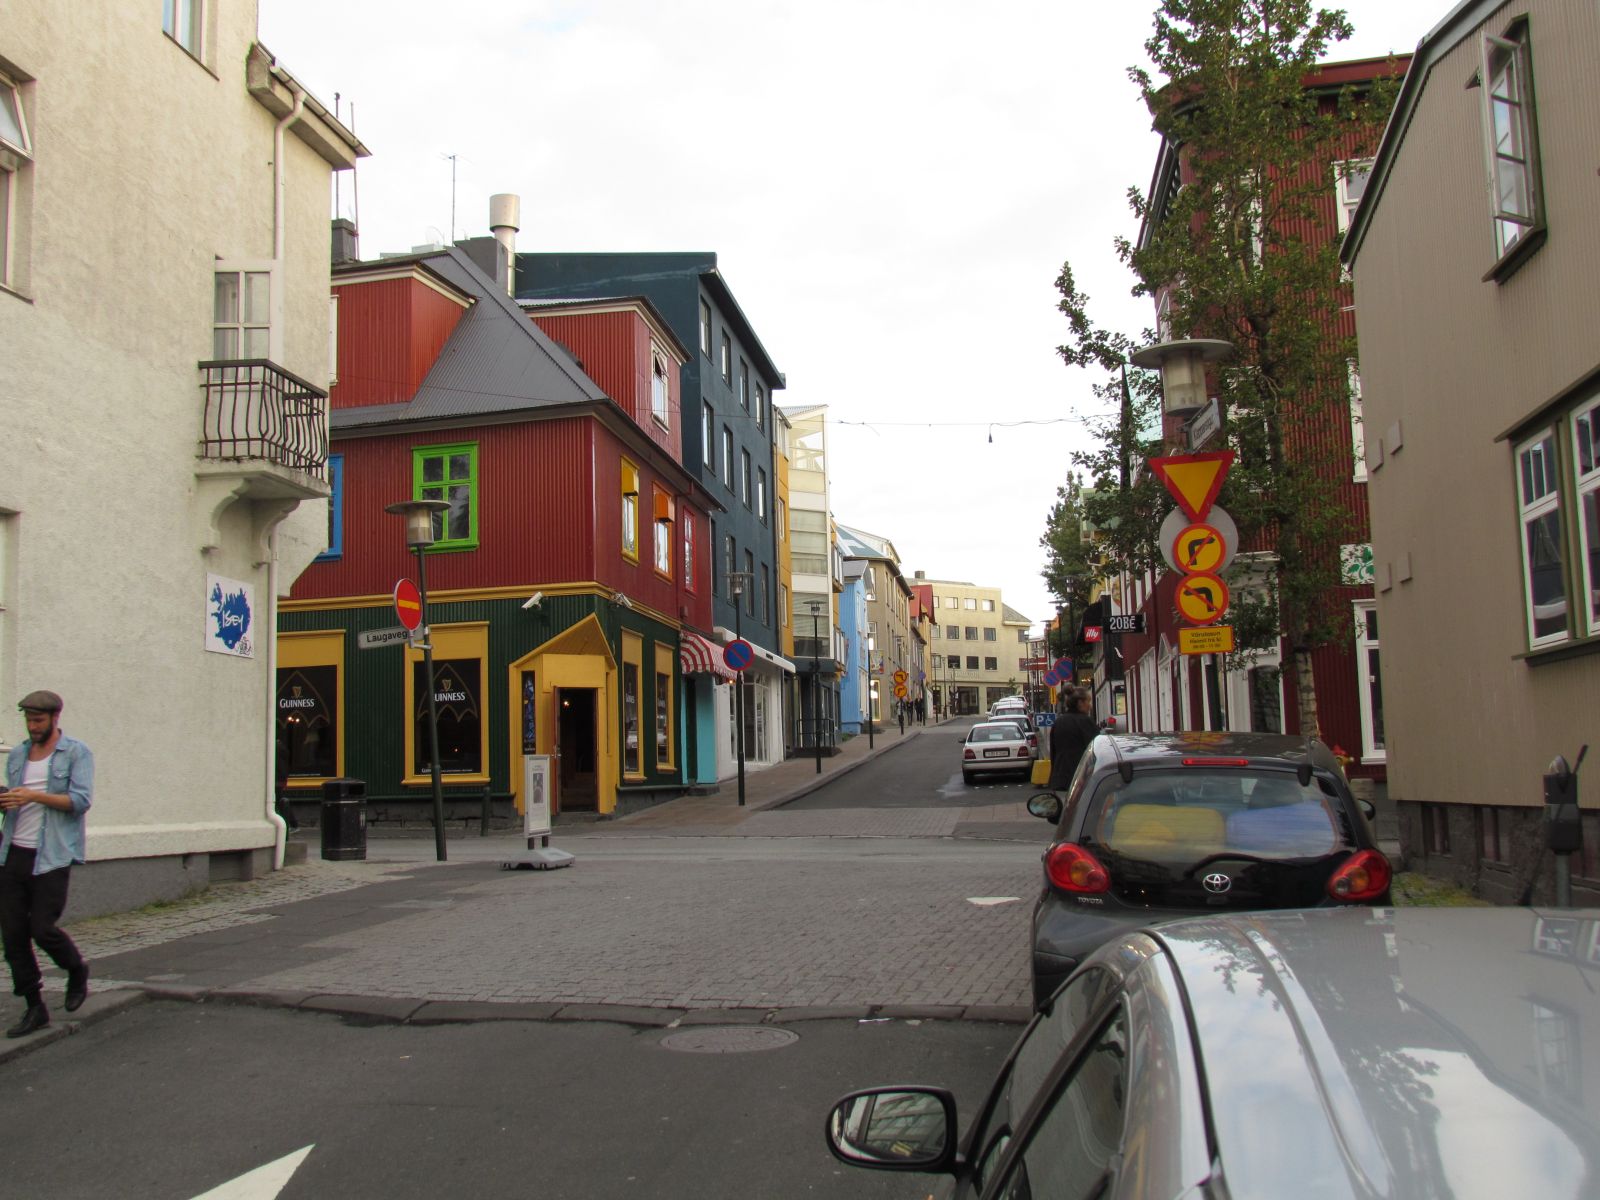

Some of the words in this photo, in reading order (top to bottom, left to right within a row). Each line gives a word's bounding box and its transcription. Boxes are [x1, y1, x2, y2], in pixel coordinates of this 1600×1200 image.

[1086, 628, 1099, 640] illy
[434, 692, 465, 702] UINNESS
[280, 699, 314, 708] GUINNESS
[1036, 715, 1043, 725] P
